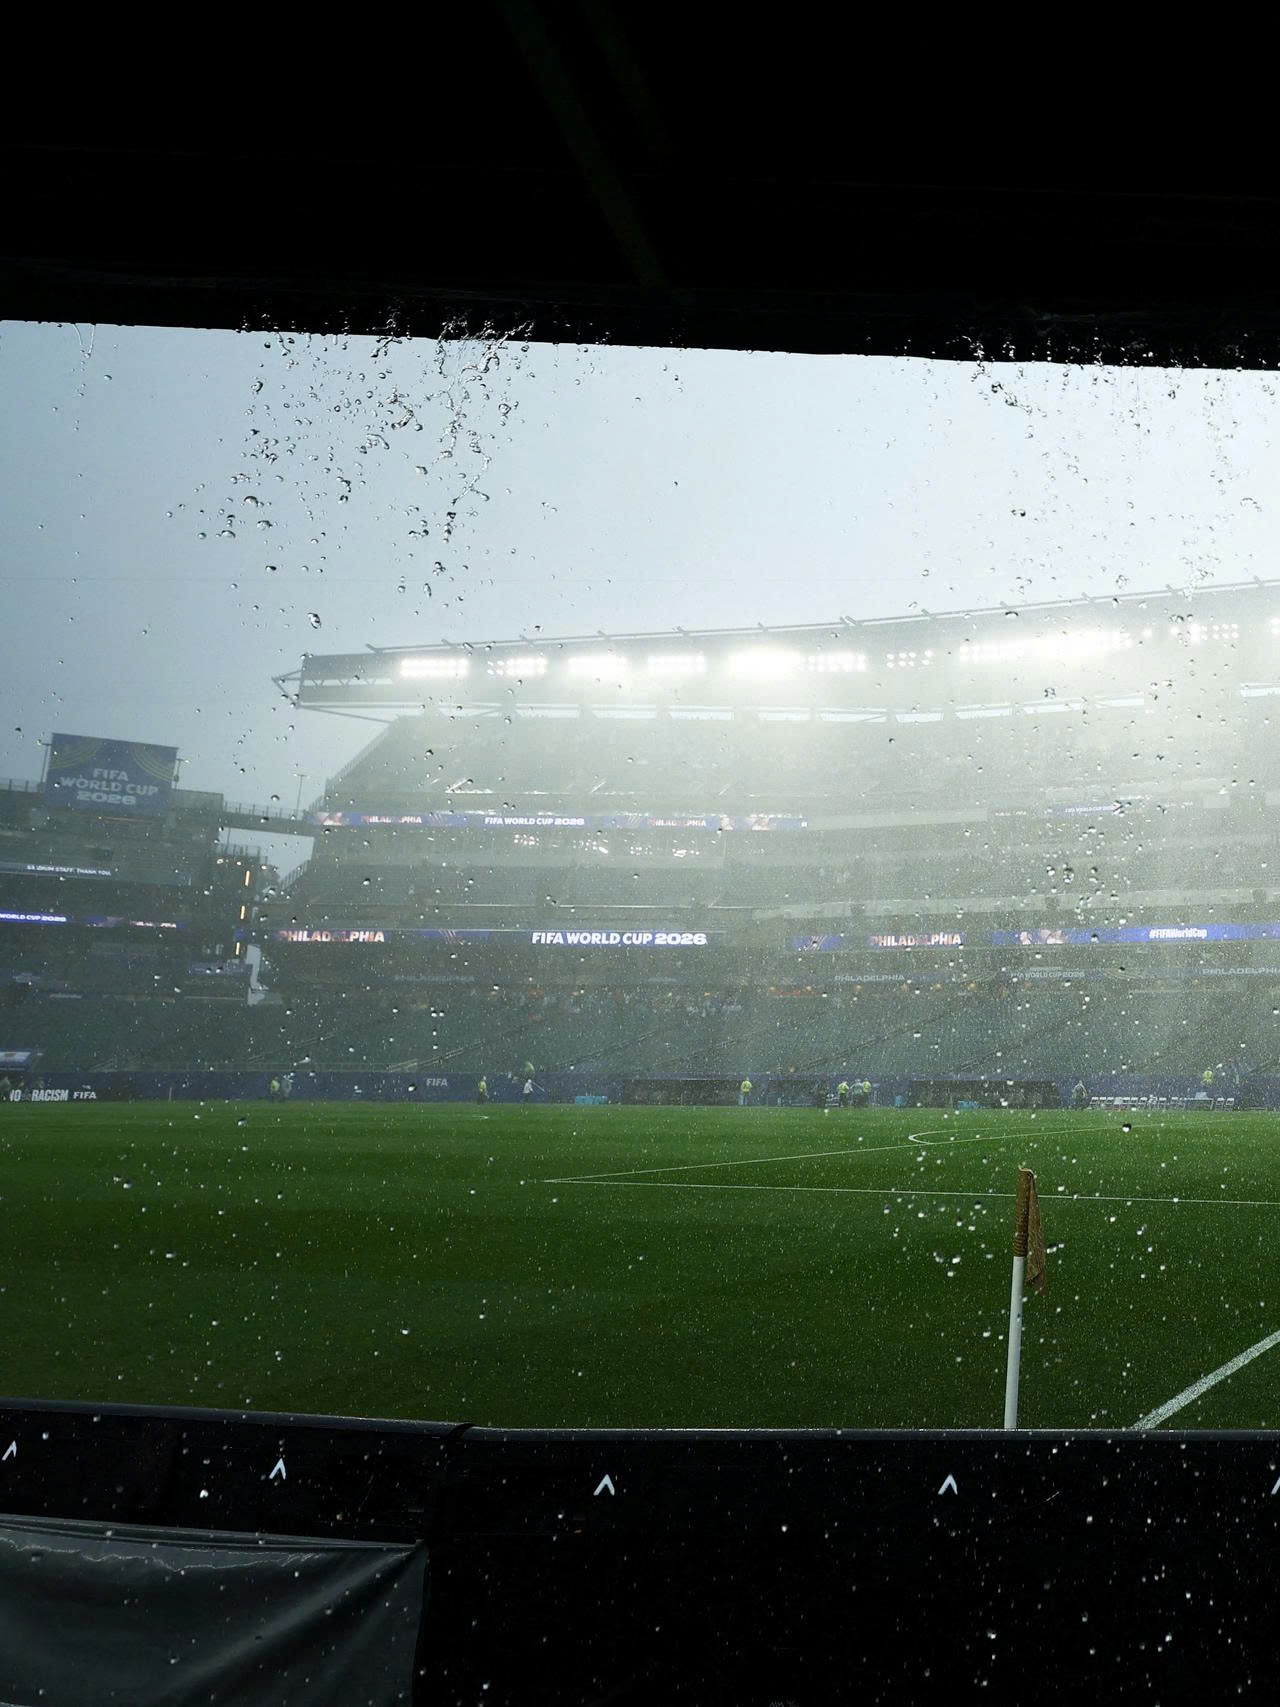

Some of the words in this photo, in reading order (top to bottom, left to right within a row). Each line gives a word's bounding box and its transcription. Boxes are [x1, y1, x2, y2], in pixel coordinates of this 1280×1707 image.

[93, 768, 128, 782] FIFA
[60, 776, 122, 792] WORLD
[126, 783, 159, 796] CUP
[77, 791, 137, 805] 2026
[485, 816, 504, 825] FIFA
[504, 817, 535, 825] WORLD
[536, 817, 554, 825] CUP
[555, 818, 585, 826] 2026
[279, 930, 385, 942] PHILADLPHIA
[532, 932, 564, 945] FIFA
[566, 932, 620, 945] WORLD
[622, 932, 653, 945] CUP
[654, 933, 707, 945] 2026
[870, 932, 961, 947] PHILADLPHIA
[1149, 928, 1207, 939] #FIFAWorldCup
[834, 974, 905, 982] PHILADELPHIA
[427, 1078, 447, 1087] FIFA
[31, 1089, 69, 1102] RACISM
[73, 1091, 96, 1100] FIFA
